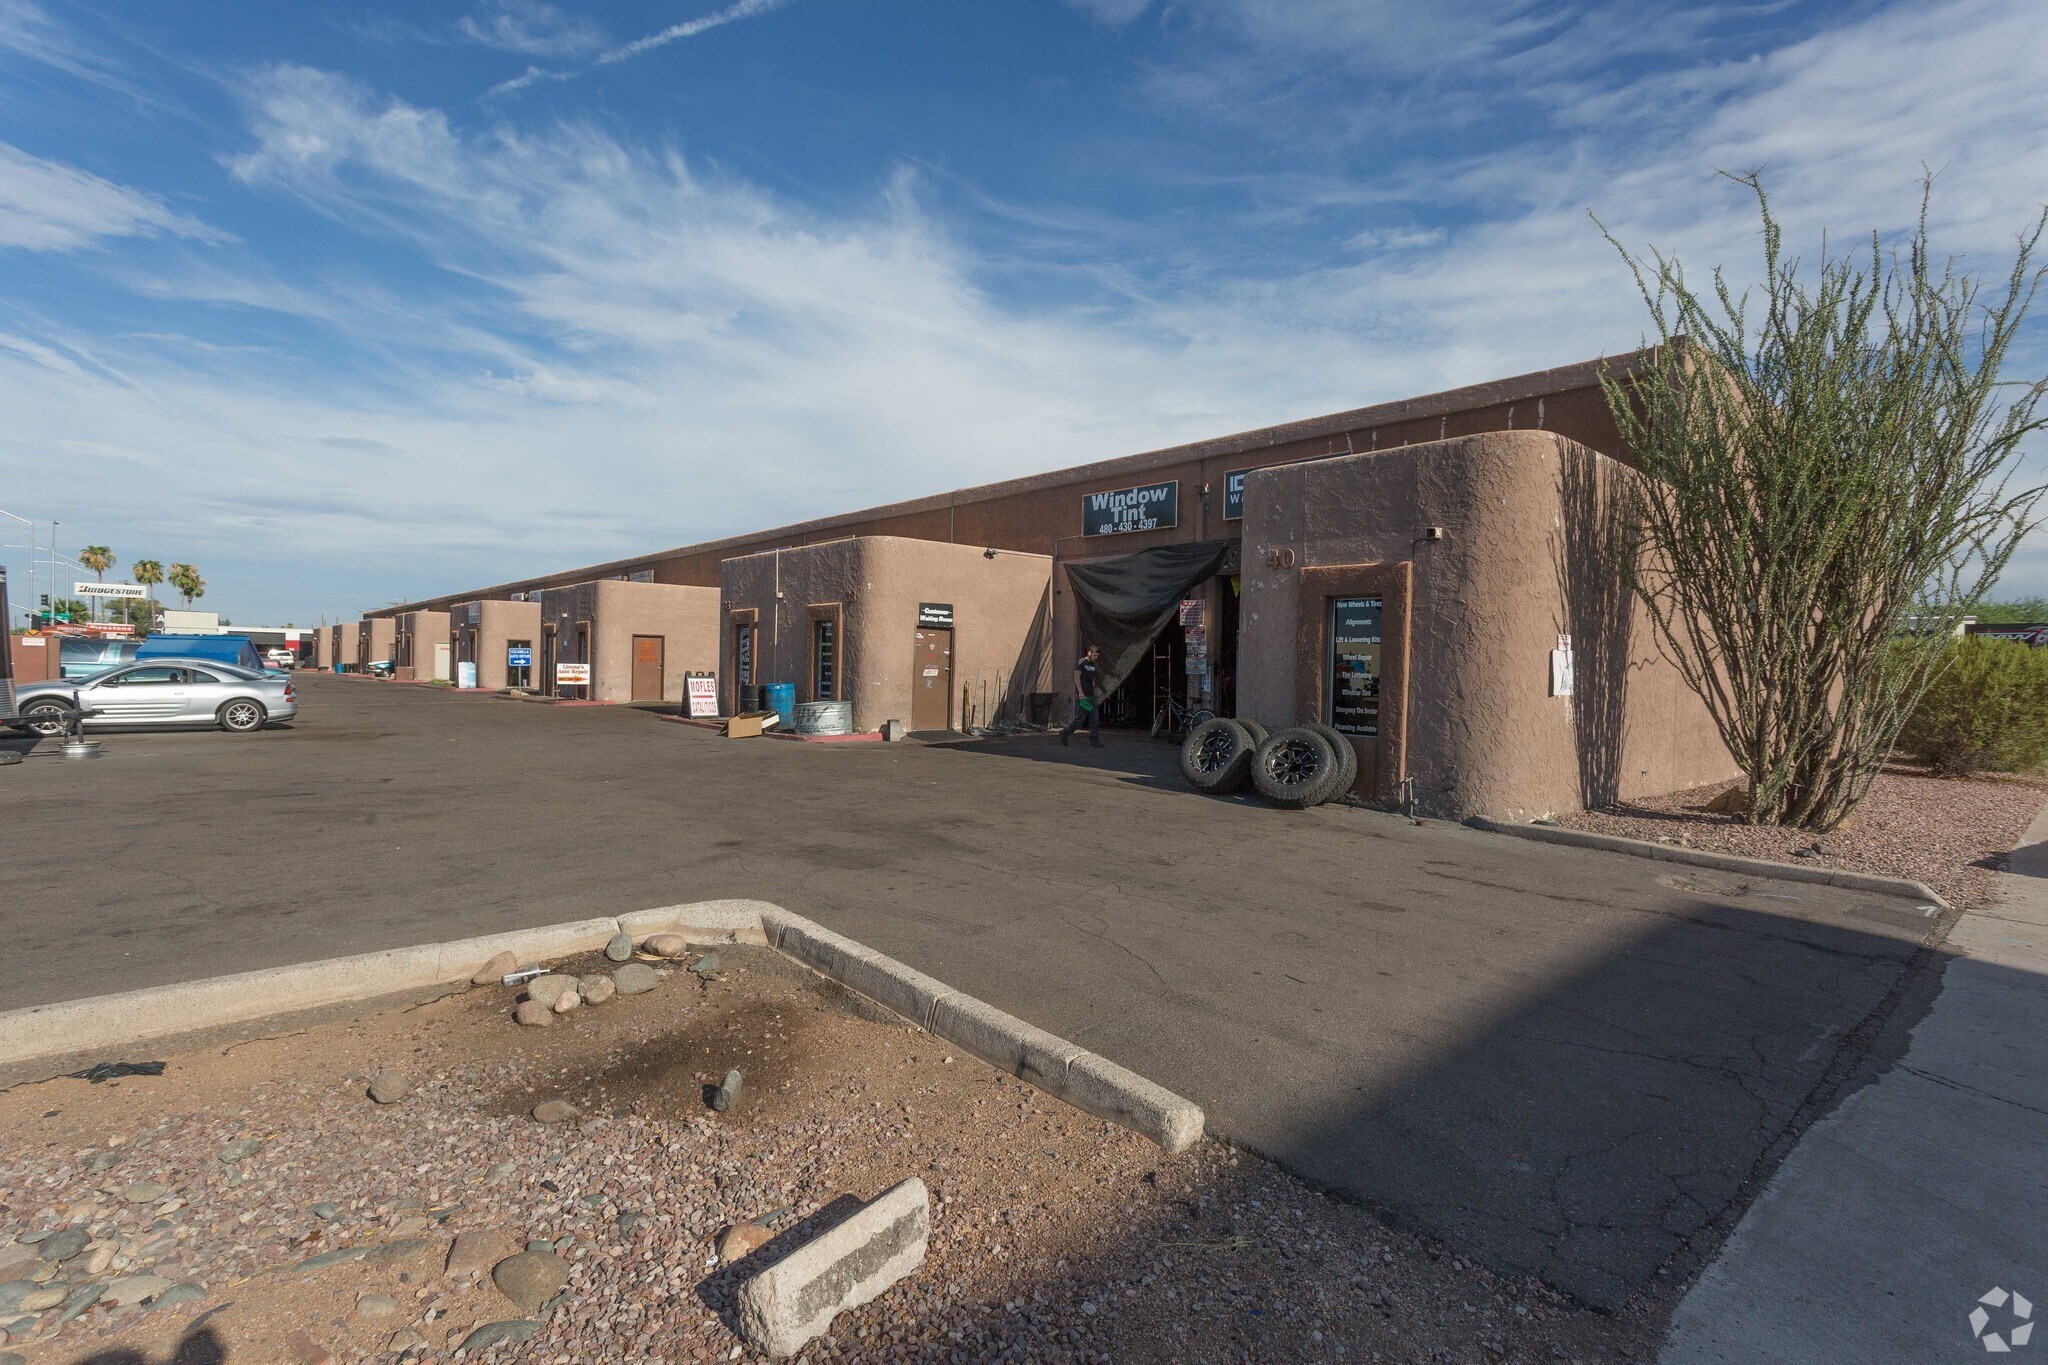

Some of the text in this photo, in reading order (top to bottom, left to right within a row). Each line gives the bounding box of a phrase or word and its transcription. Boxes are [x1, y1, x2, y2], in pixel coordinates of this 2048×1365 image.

[1091, 487, 1168, 510] Window
[1111, 503, 1146, 523] Tint
[1267, 548, 1295, 569] 40
[78, 585, 144, 595] BRIDGESTONE
[924, 607, 950, 615] Customer
[920, 614, 938, 623] Waiting
[1345, 618, 1372, 627] Alignments
[1349, 636, 1371, 645] Lowering
[1358, 654, 1373, 662] Repair
[1351, 671, 1373, 680] Lettering
[690, 680, 715, 692] MOFLES
[1341, 688, 1372, 697] Window Tint
[1335, 706, 1356, 715] Emergency
[1334, 723, 1378, 733] Financing Available
